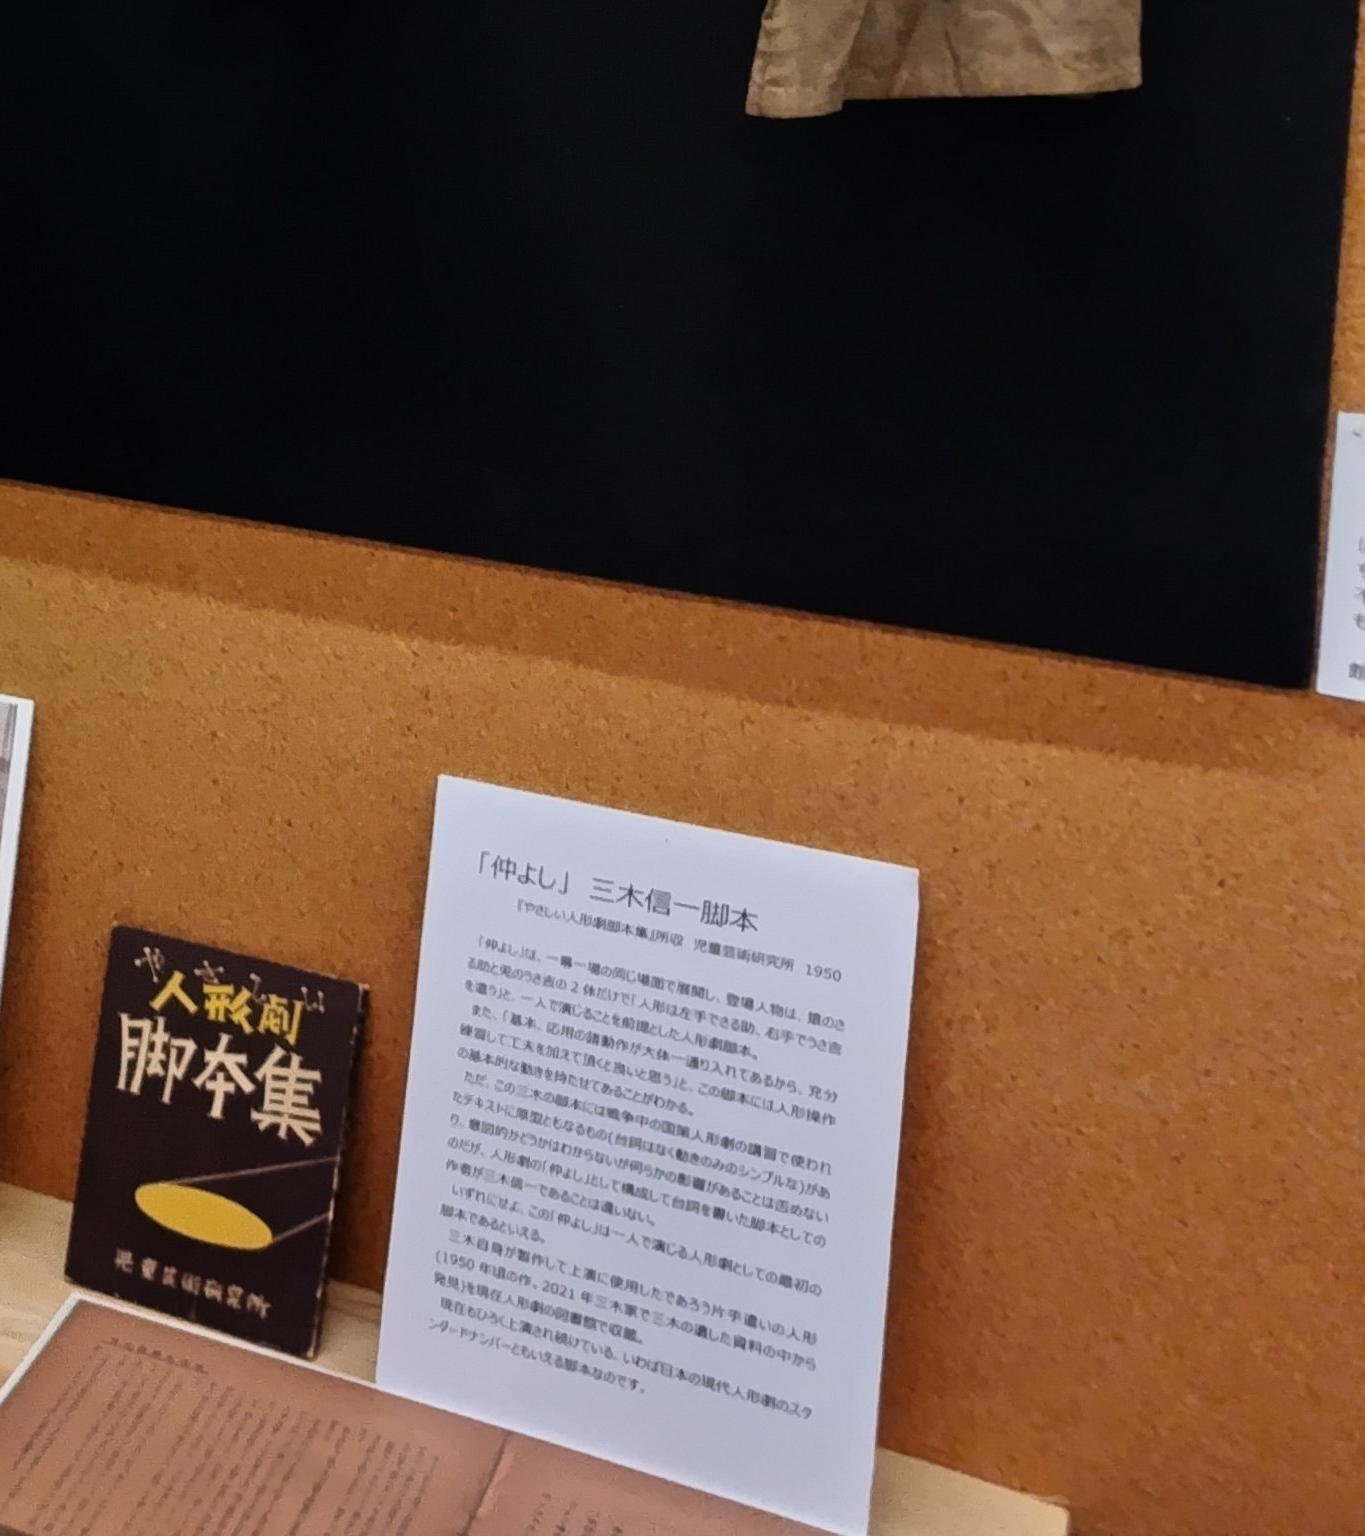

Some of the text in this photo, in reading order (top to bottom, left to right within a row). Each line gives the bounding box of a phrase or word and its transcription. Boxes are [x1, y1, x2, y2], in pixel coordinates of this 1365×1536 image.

[478, 849, 760, 934] 「仲よし」 三木信一脚本
[149, 969, 305, 1044] 人形劇
[805, 962, 841, 983] 1950
[116, 1012, 325, 1148] 脚本集
